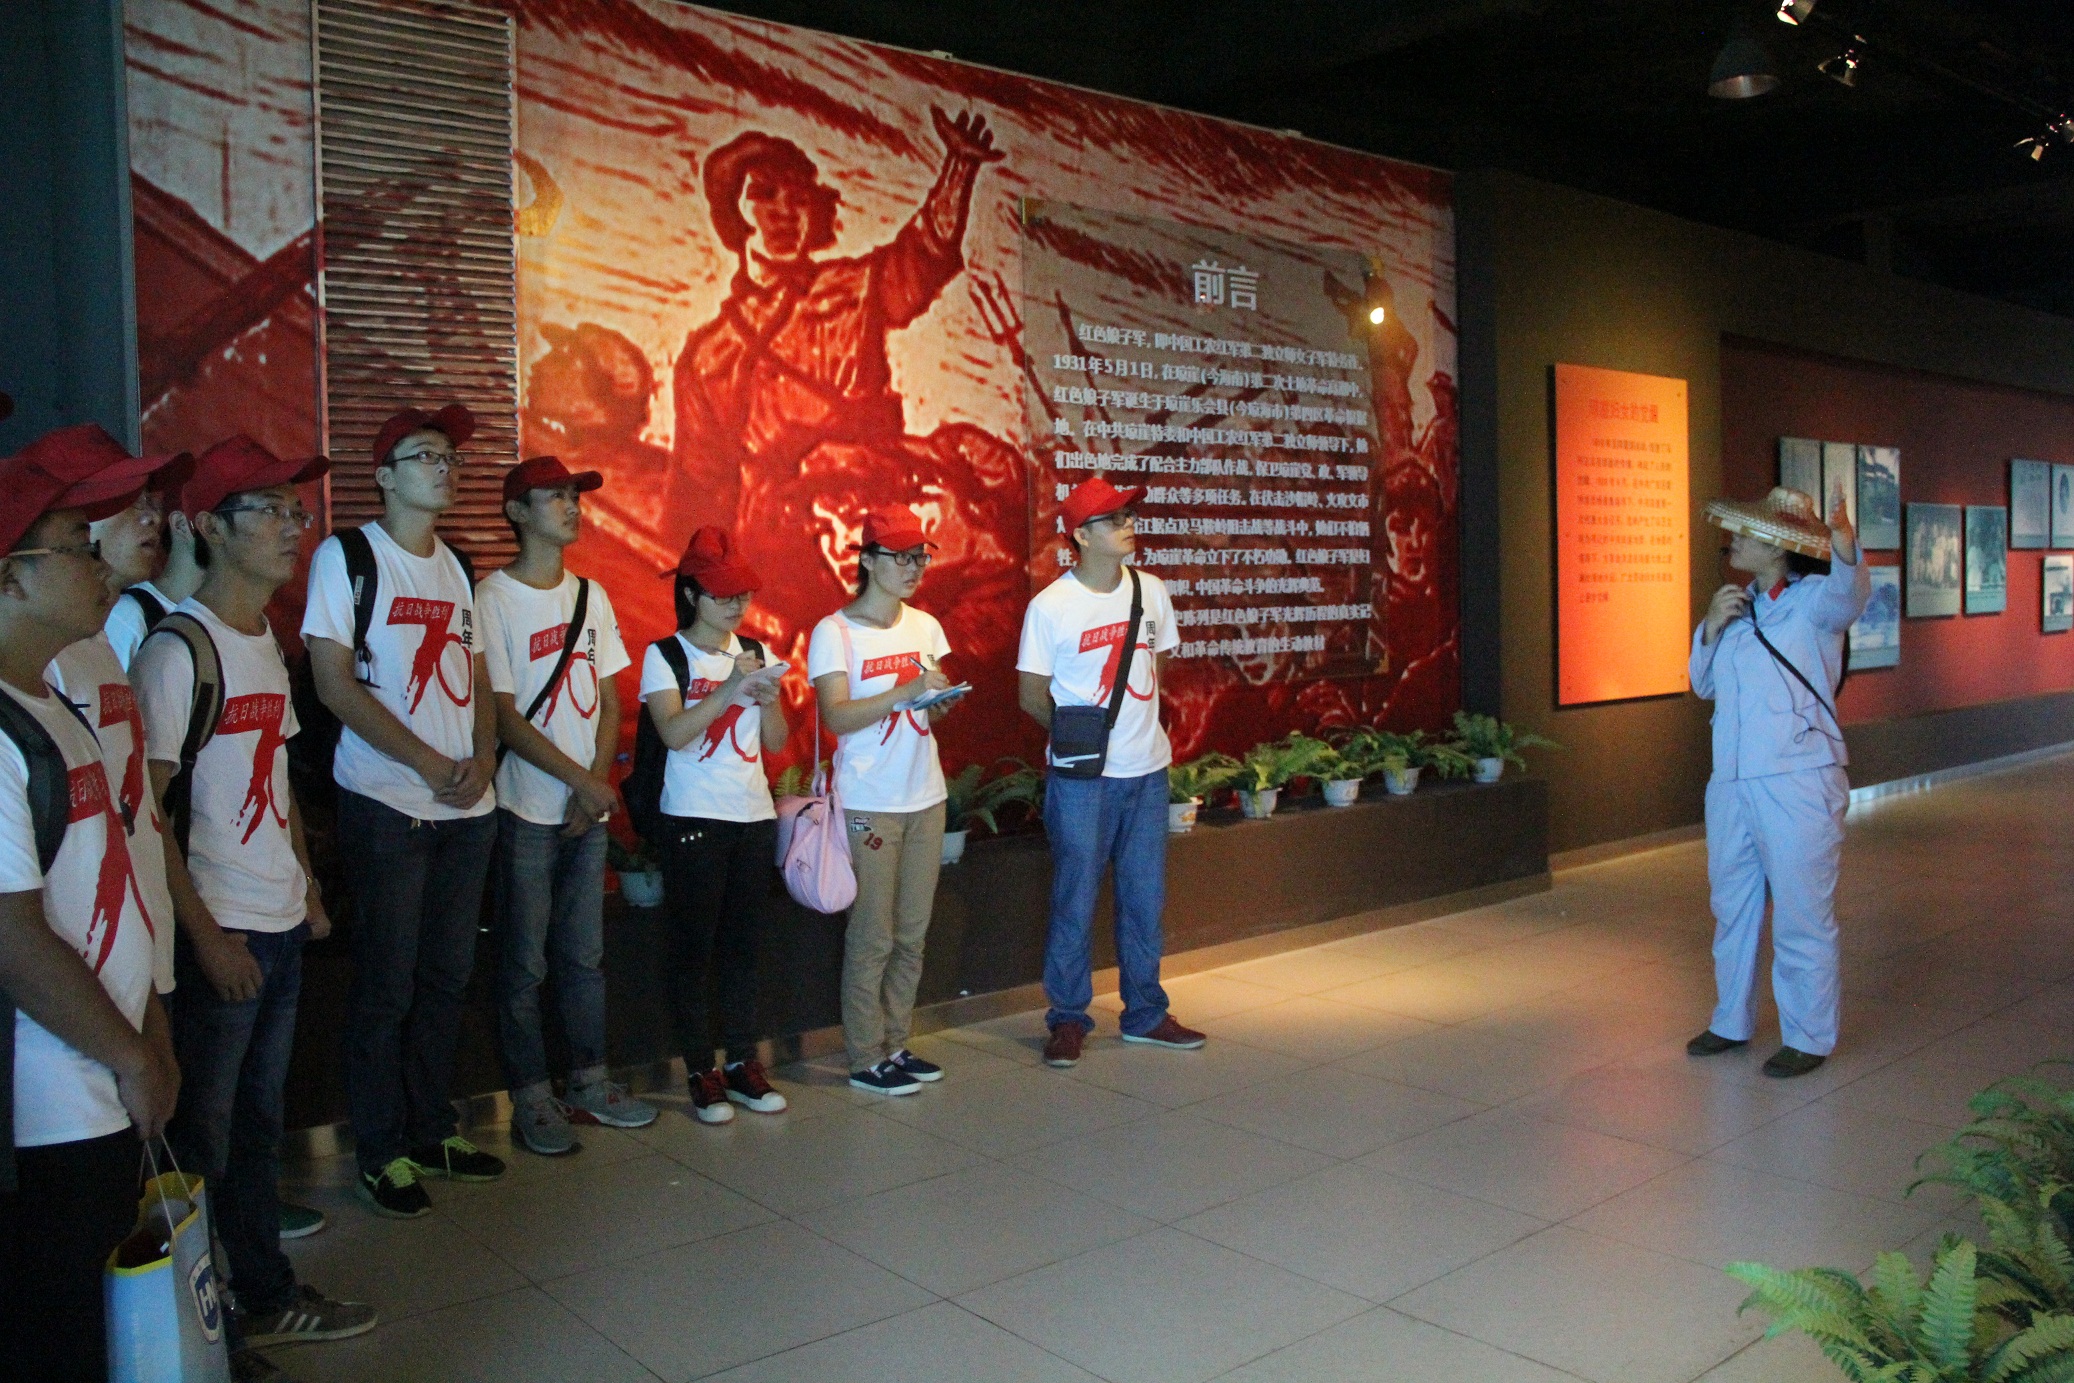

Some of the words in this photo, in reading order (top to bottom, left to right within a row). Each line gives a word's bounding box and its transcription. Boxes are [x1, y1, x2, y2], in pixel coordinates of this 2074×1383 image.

[1192, 259, 1259, 311] 前言
[392, 601, 450, 621] 抗日战争胜利
[462, 608, 473, 648] 周年
[531, 626, 568, 653] 抗日战争
[1081, 624, 1128, 647] 抗日战争胜
[386, 597, 472, 715] 70
[863, 832, 883, 851] 19
